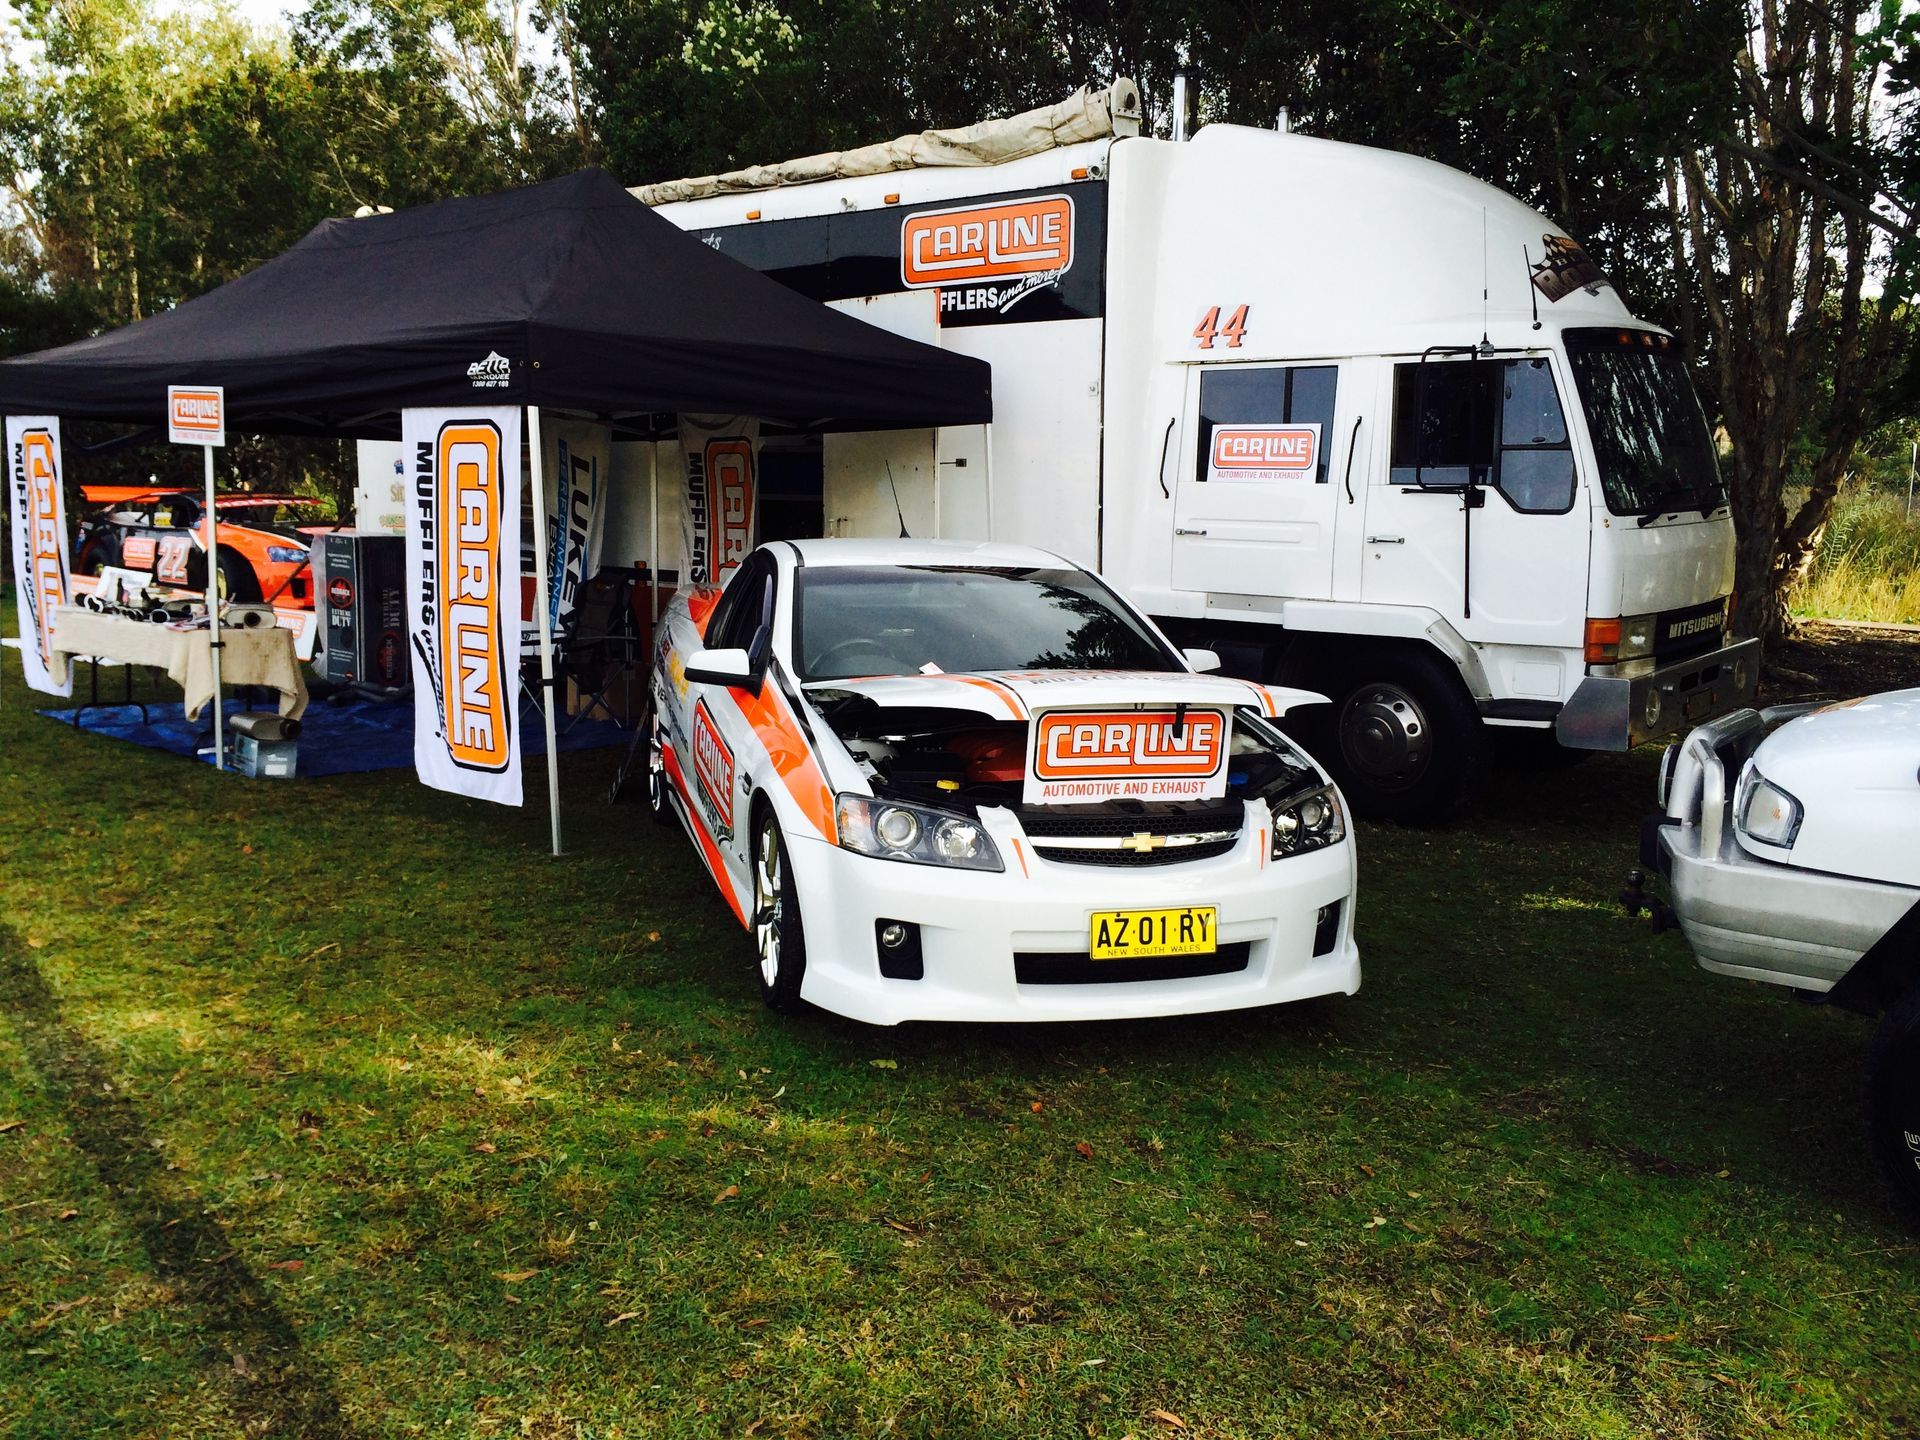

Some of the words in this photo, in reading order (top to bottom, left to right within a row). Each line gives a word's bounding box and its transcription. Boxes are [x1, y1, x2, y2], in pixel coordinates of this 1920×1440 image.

[912, 211, 1062, 272] CARLINE
[940, 287, 998, 312] FFLERS
[1192, 304, 1250, 349] 44
[467, 358, 511, 375] BETTA
[174, 398, 219, 424] CARLINE
[1220, 437, 1308, 462] CARLINE
[1217, 471, 1257, 479] AUTOMOTIVE
[1259, 471, 1272, 479] AND
[1274, 471, 1304, 479] EXHAUST
[549, 446, 569, 634] PERFORMANCE
[558, 454, 590, 635] LUKEY
[158, 538, 192, 583] 22
[448, 441, 495, 752] CARLINE
[332, 616, 352, 627] DUTY
[1669, 612, 1722, 638] MITSUBISHI
[1046, 723, 1213, 767] CARLINE
[695, 712, 731, 822] CARLINE
[1043, 783, 1120, 797] AUTOMOTIVE
[1123, 783, 1148, 795] AND
[1151, 781, 1206, 794] EXHAUST
[1133, 947, 1165, 955] SOUTH
[1171, 944, 1200, 952] WALES
